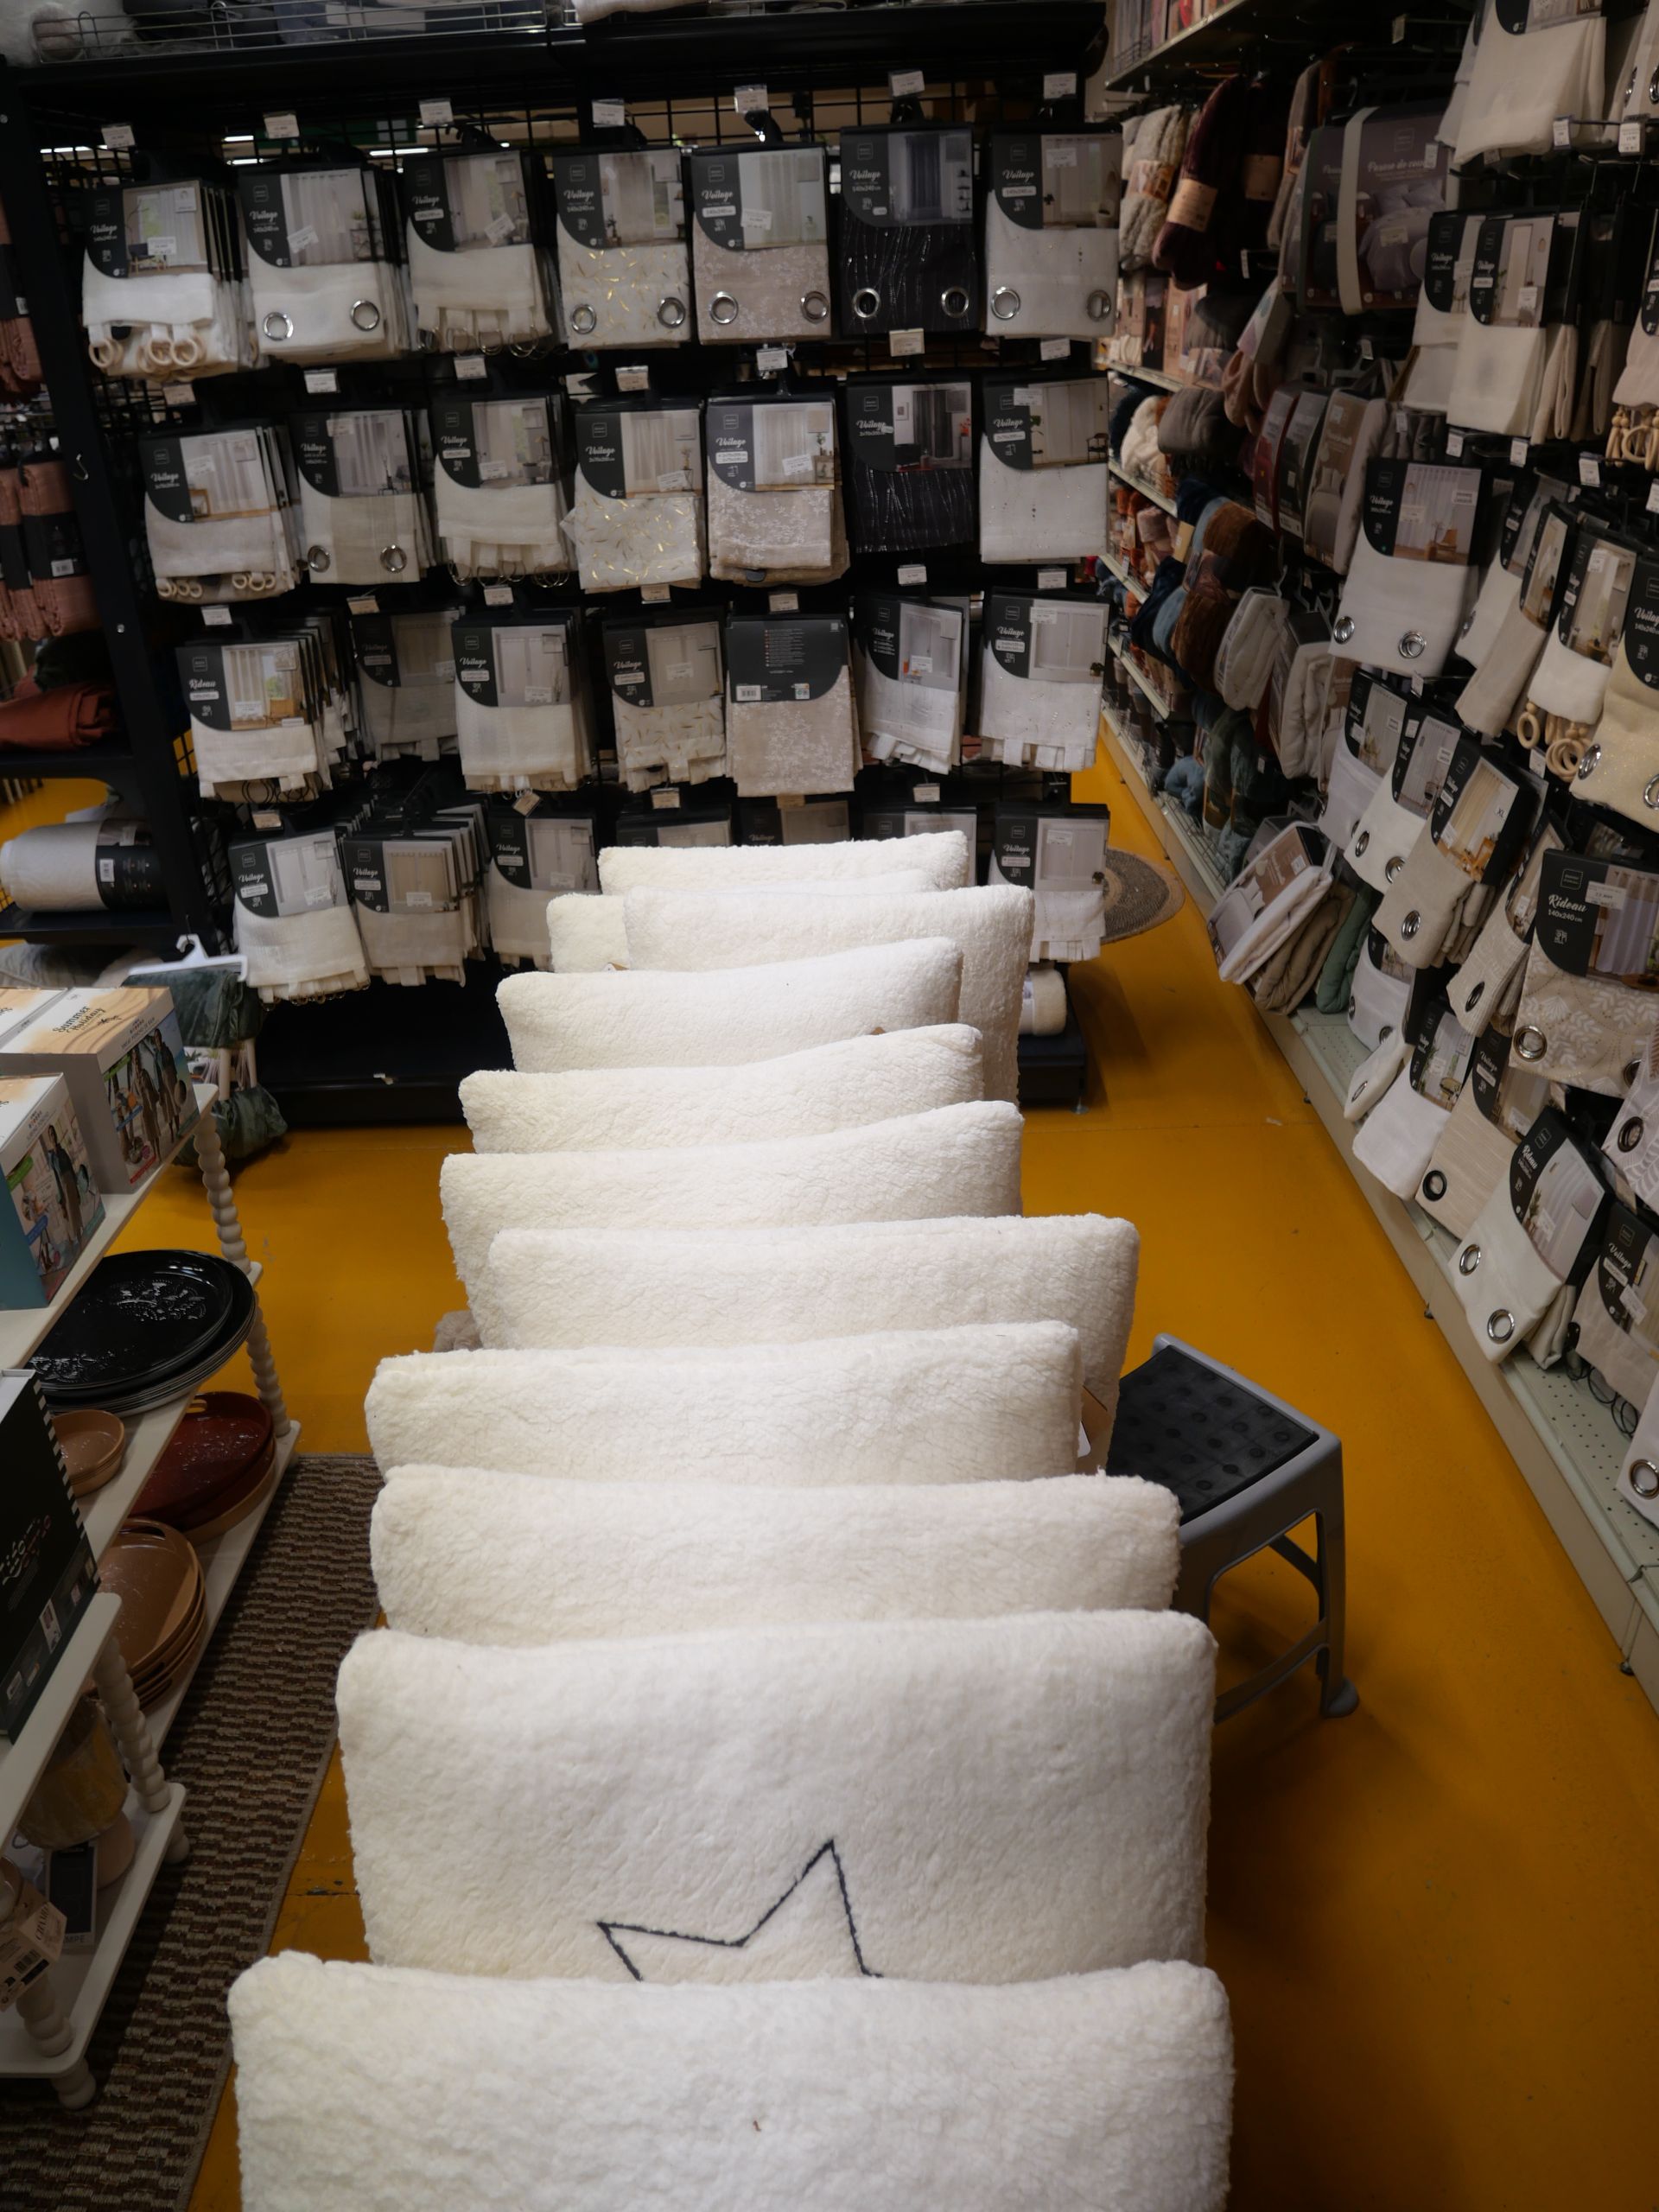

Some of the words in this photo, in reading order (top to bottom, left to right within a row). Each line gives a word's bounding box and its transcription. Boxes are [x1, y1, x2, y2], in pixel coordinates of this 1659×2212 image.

[849, 169, 880, 181] Voilage
[1002, 168, 1034, 181] Voilage
[563, 189, 594, 201] Voilage
[701, 189, 733, 201] Voilage
[993, 418, 1023, 429] Voilage
[1634, 607, 1659, 631] Voilag
[997, 626, 1024, 638] Voilage
[460, 657, 486, 668] Voilage
[1548, 893, 1588, 912] Rideau
[53, 1006, 90, 1033] Summer
[67, 1007, 106, 1033] Holiday
